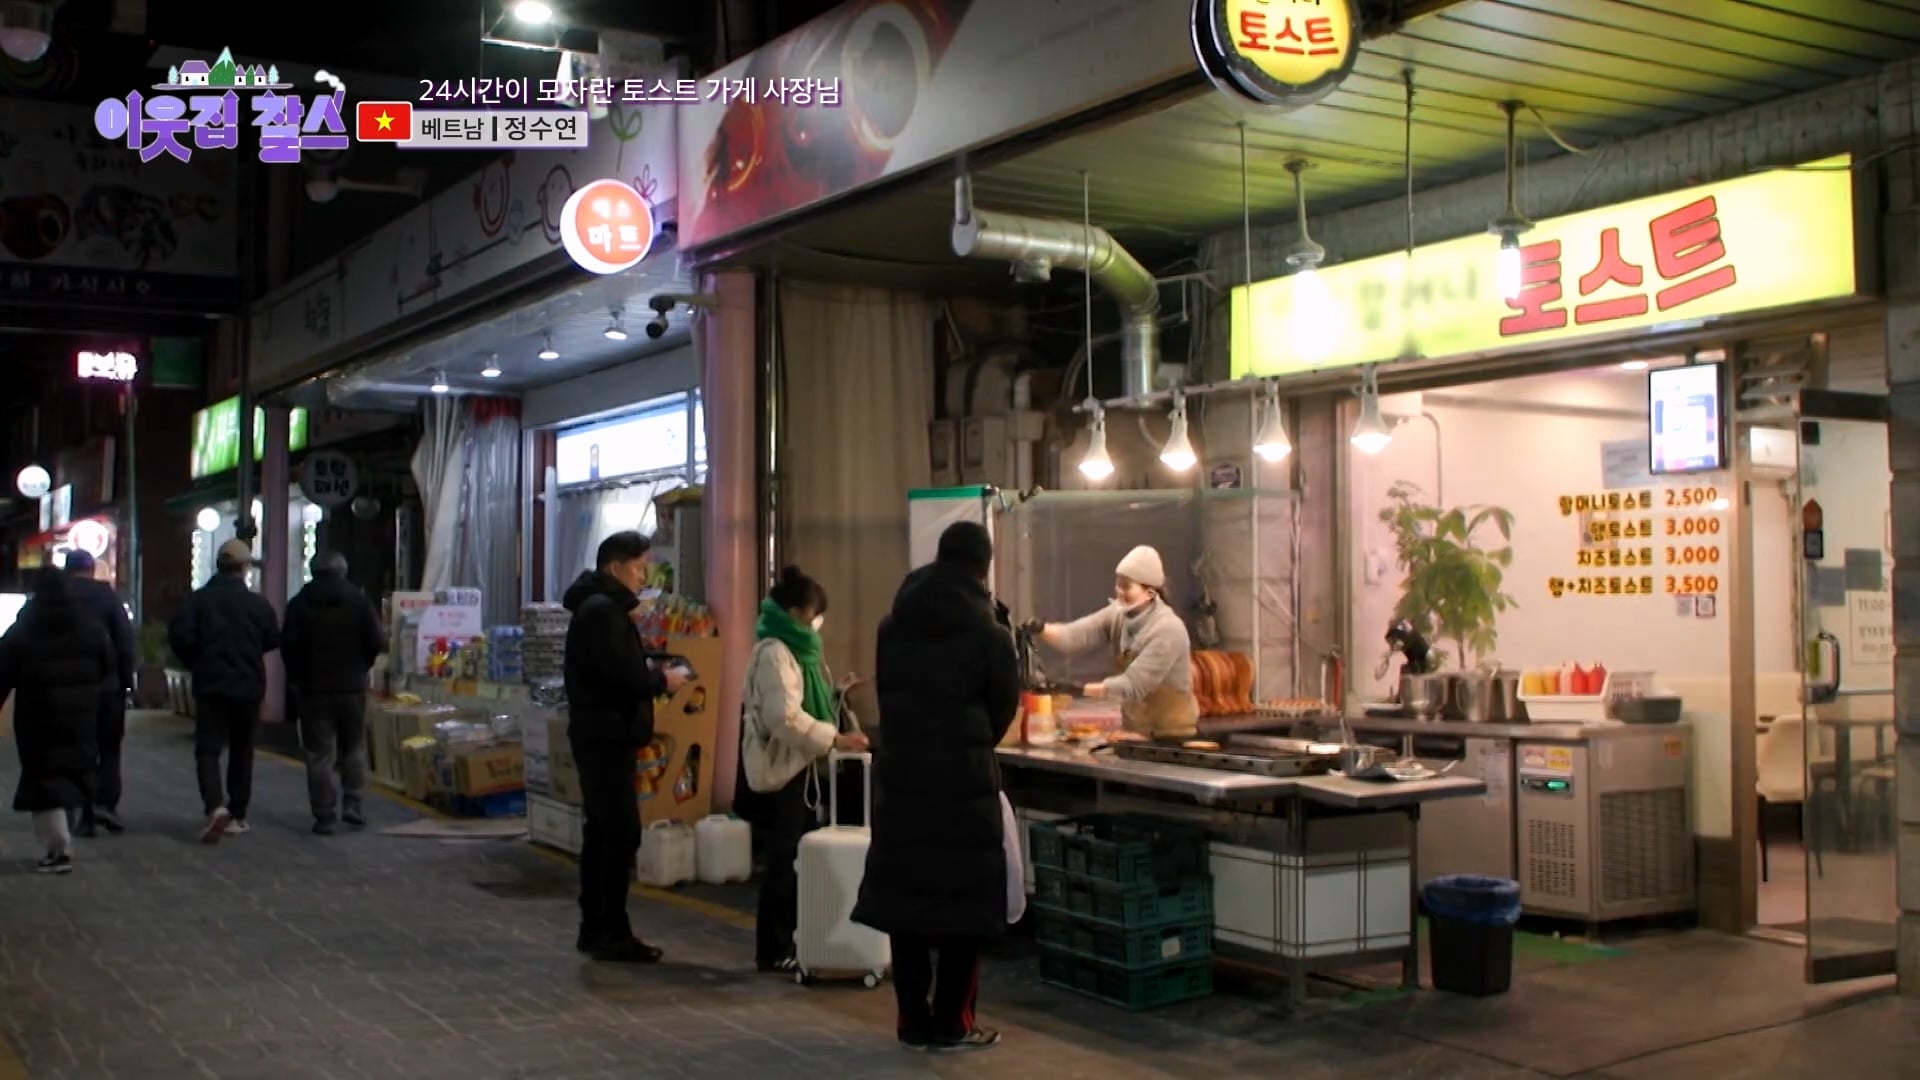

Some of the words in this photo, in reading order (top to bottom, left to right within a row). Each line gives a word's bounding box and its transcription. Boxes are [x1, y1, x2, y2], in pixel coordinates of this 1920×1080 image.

[1239, 11, 1339, 55] 토스트
[1499, 195, 1737, 336] 토스트
[1590, 520, 1652, 541] 햄토스트
[1577, 547, 1652, 566] 치즈토스트
